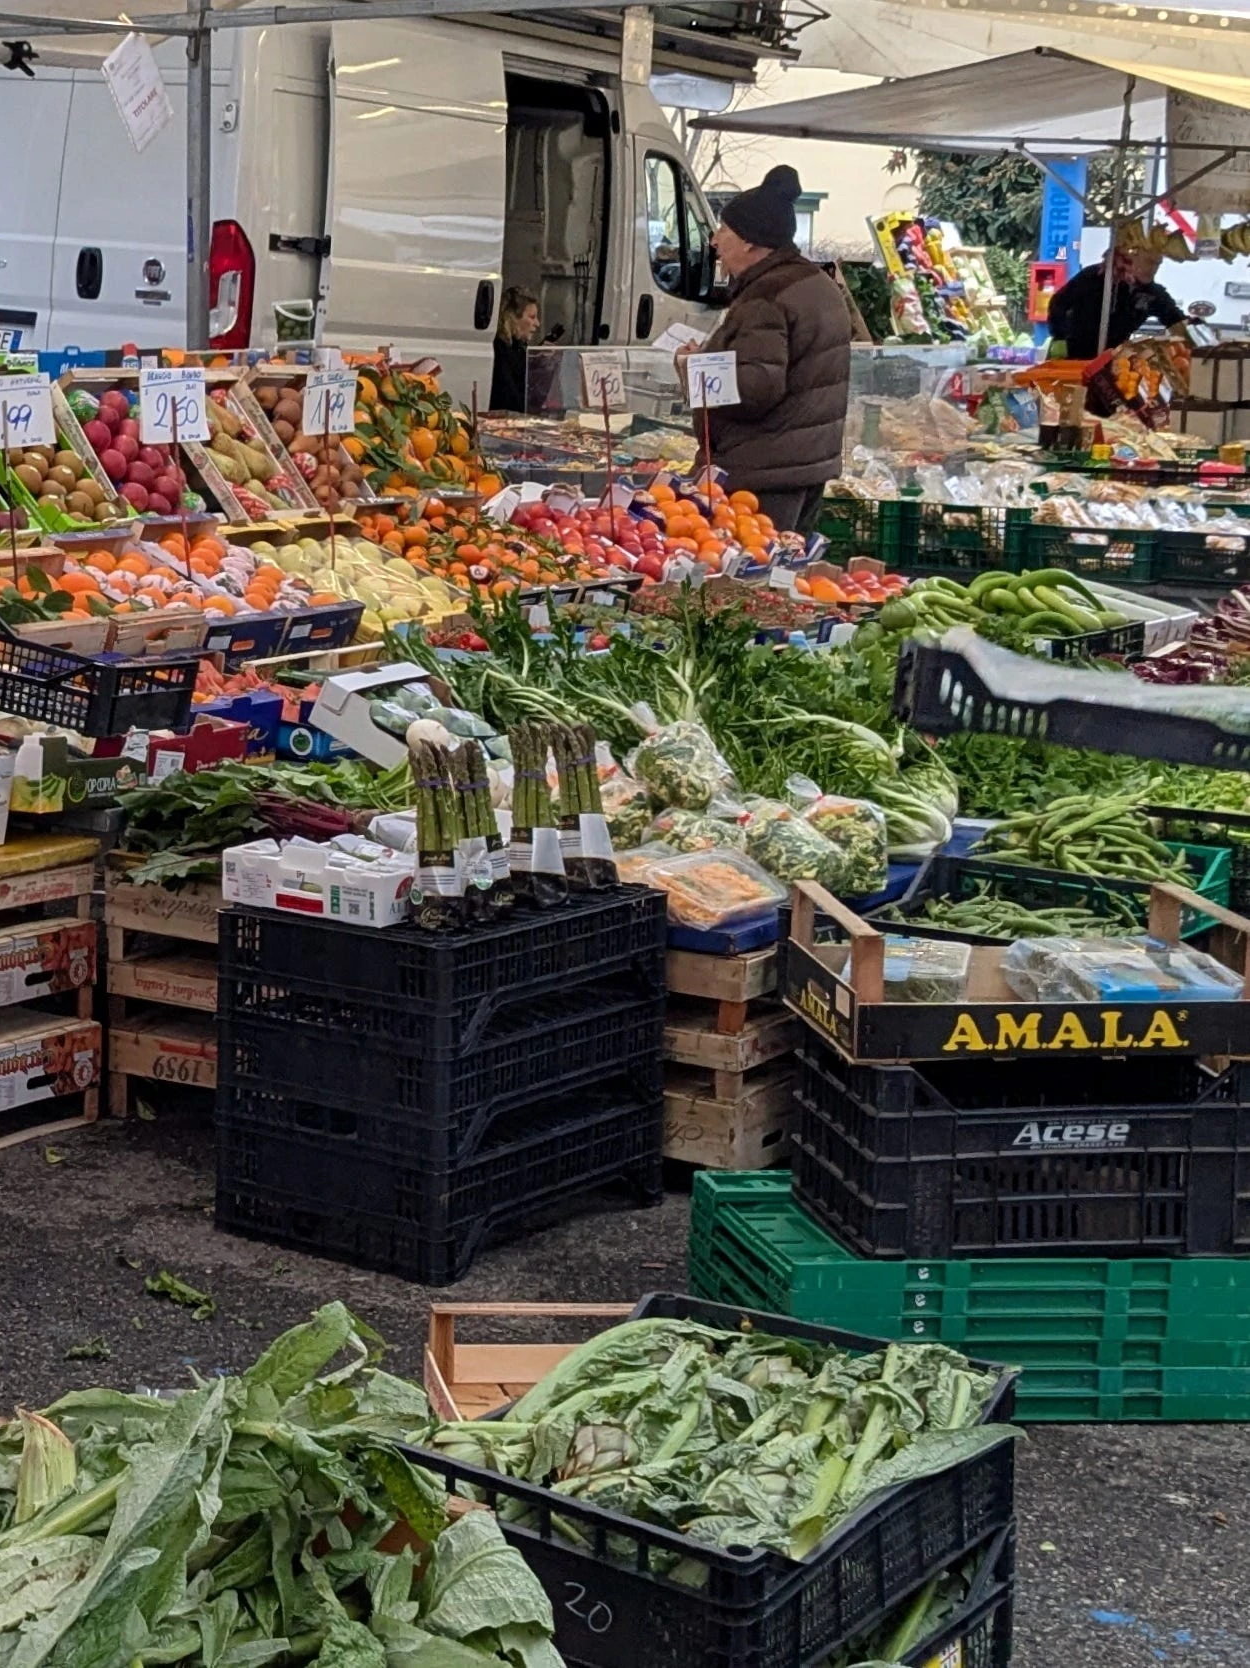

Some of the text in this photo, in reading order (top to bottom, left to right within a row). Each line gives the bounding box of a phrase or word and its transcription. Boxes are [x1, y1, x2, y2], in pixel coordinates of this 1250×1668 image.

[153, 392, 199, 433] 2,50
[153, 1055, 200, 1083] 1959
[1012, 1121, 1130, 1146] Acese
[564, 1581, 613, 1633] 20
